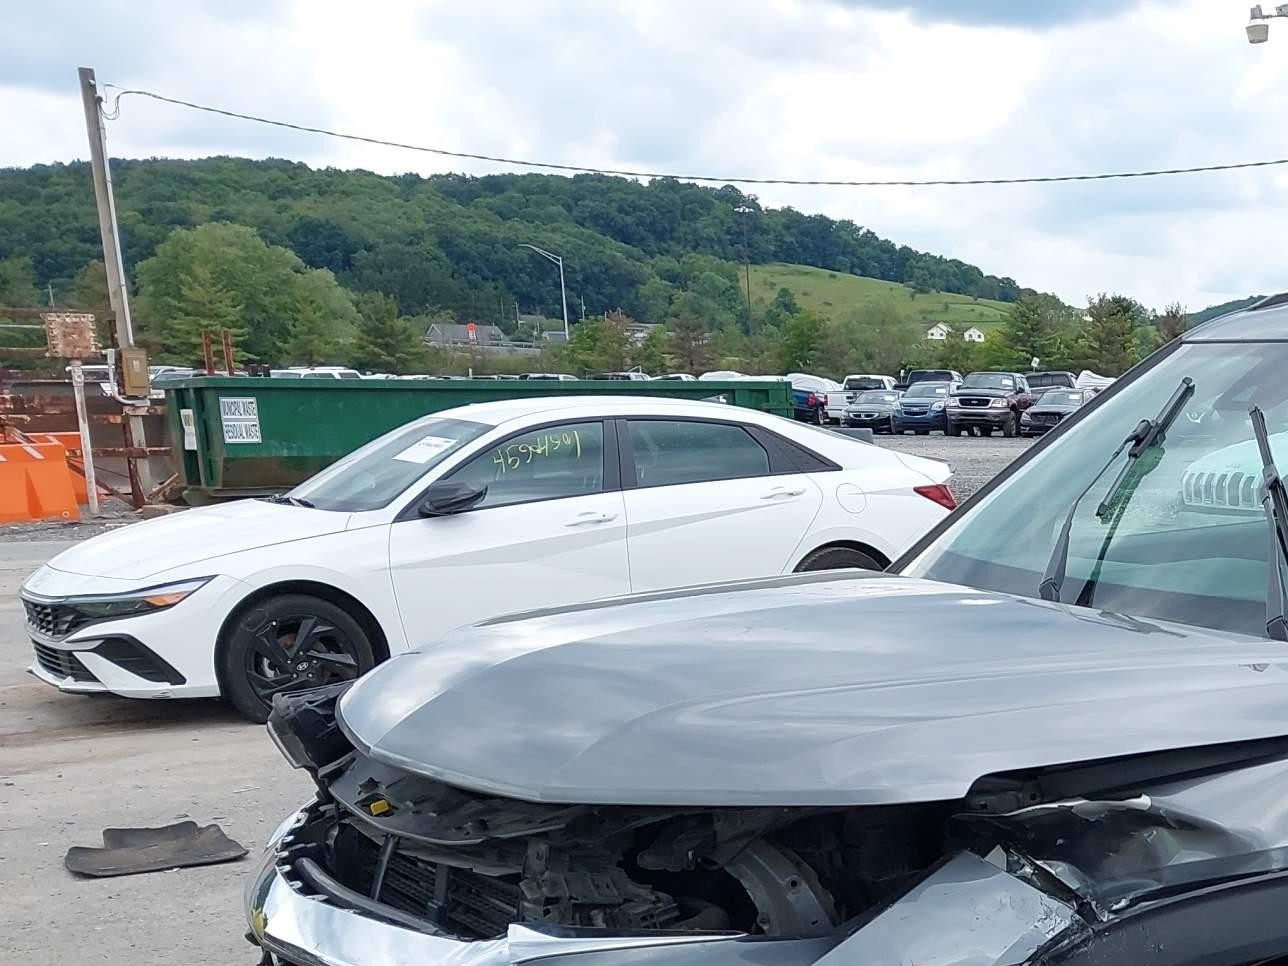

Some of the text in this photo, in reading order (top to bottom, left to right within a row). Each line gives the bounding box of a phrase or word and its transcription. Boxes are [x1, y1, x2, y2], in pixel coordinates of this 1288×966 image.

[222, 400, 256, 416] MUNICIPAL WASTE
[225, 424, 258, 440] RESIDUAL WASTE
